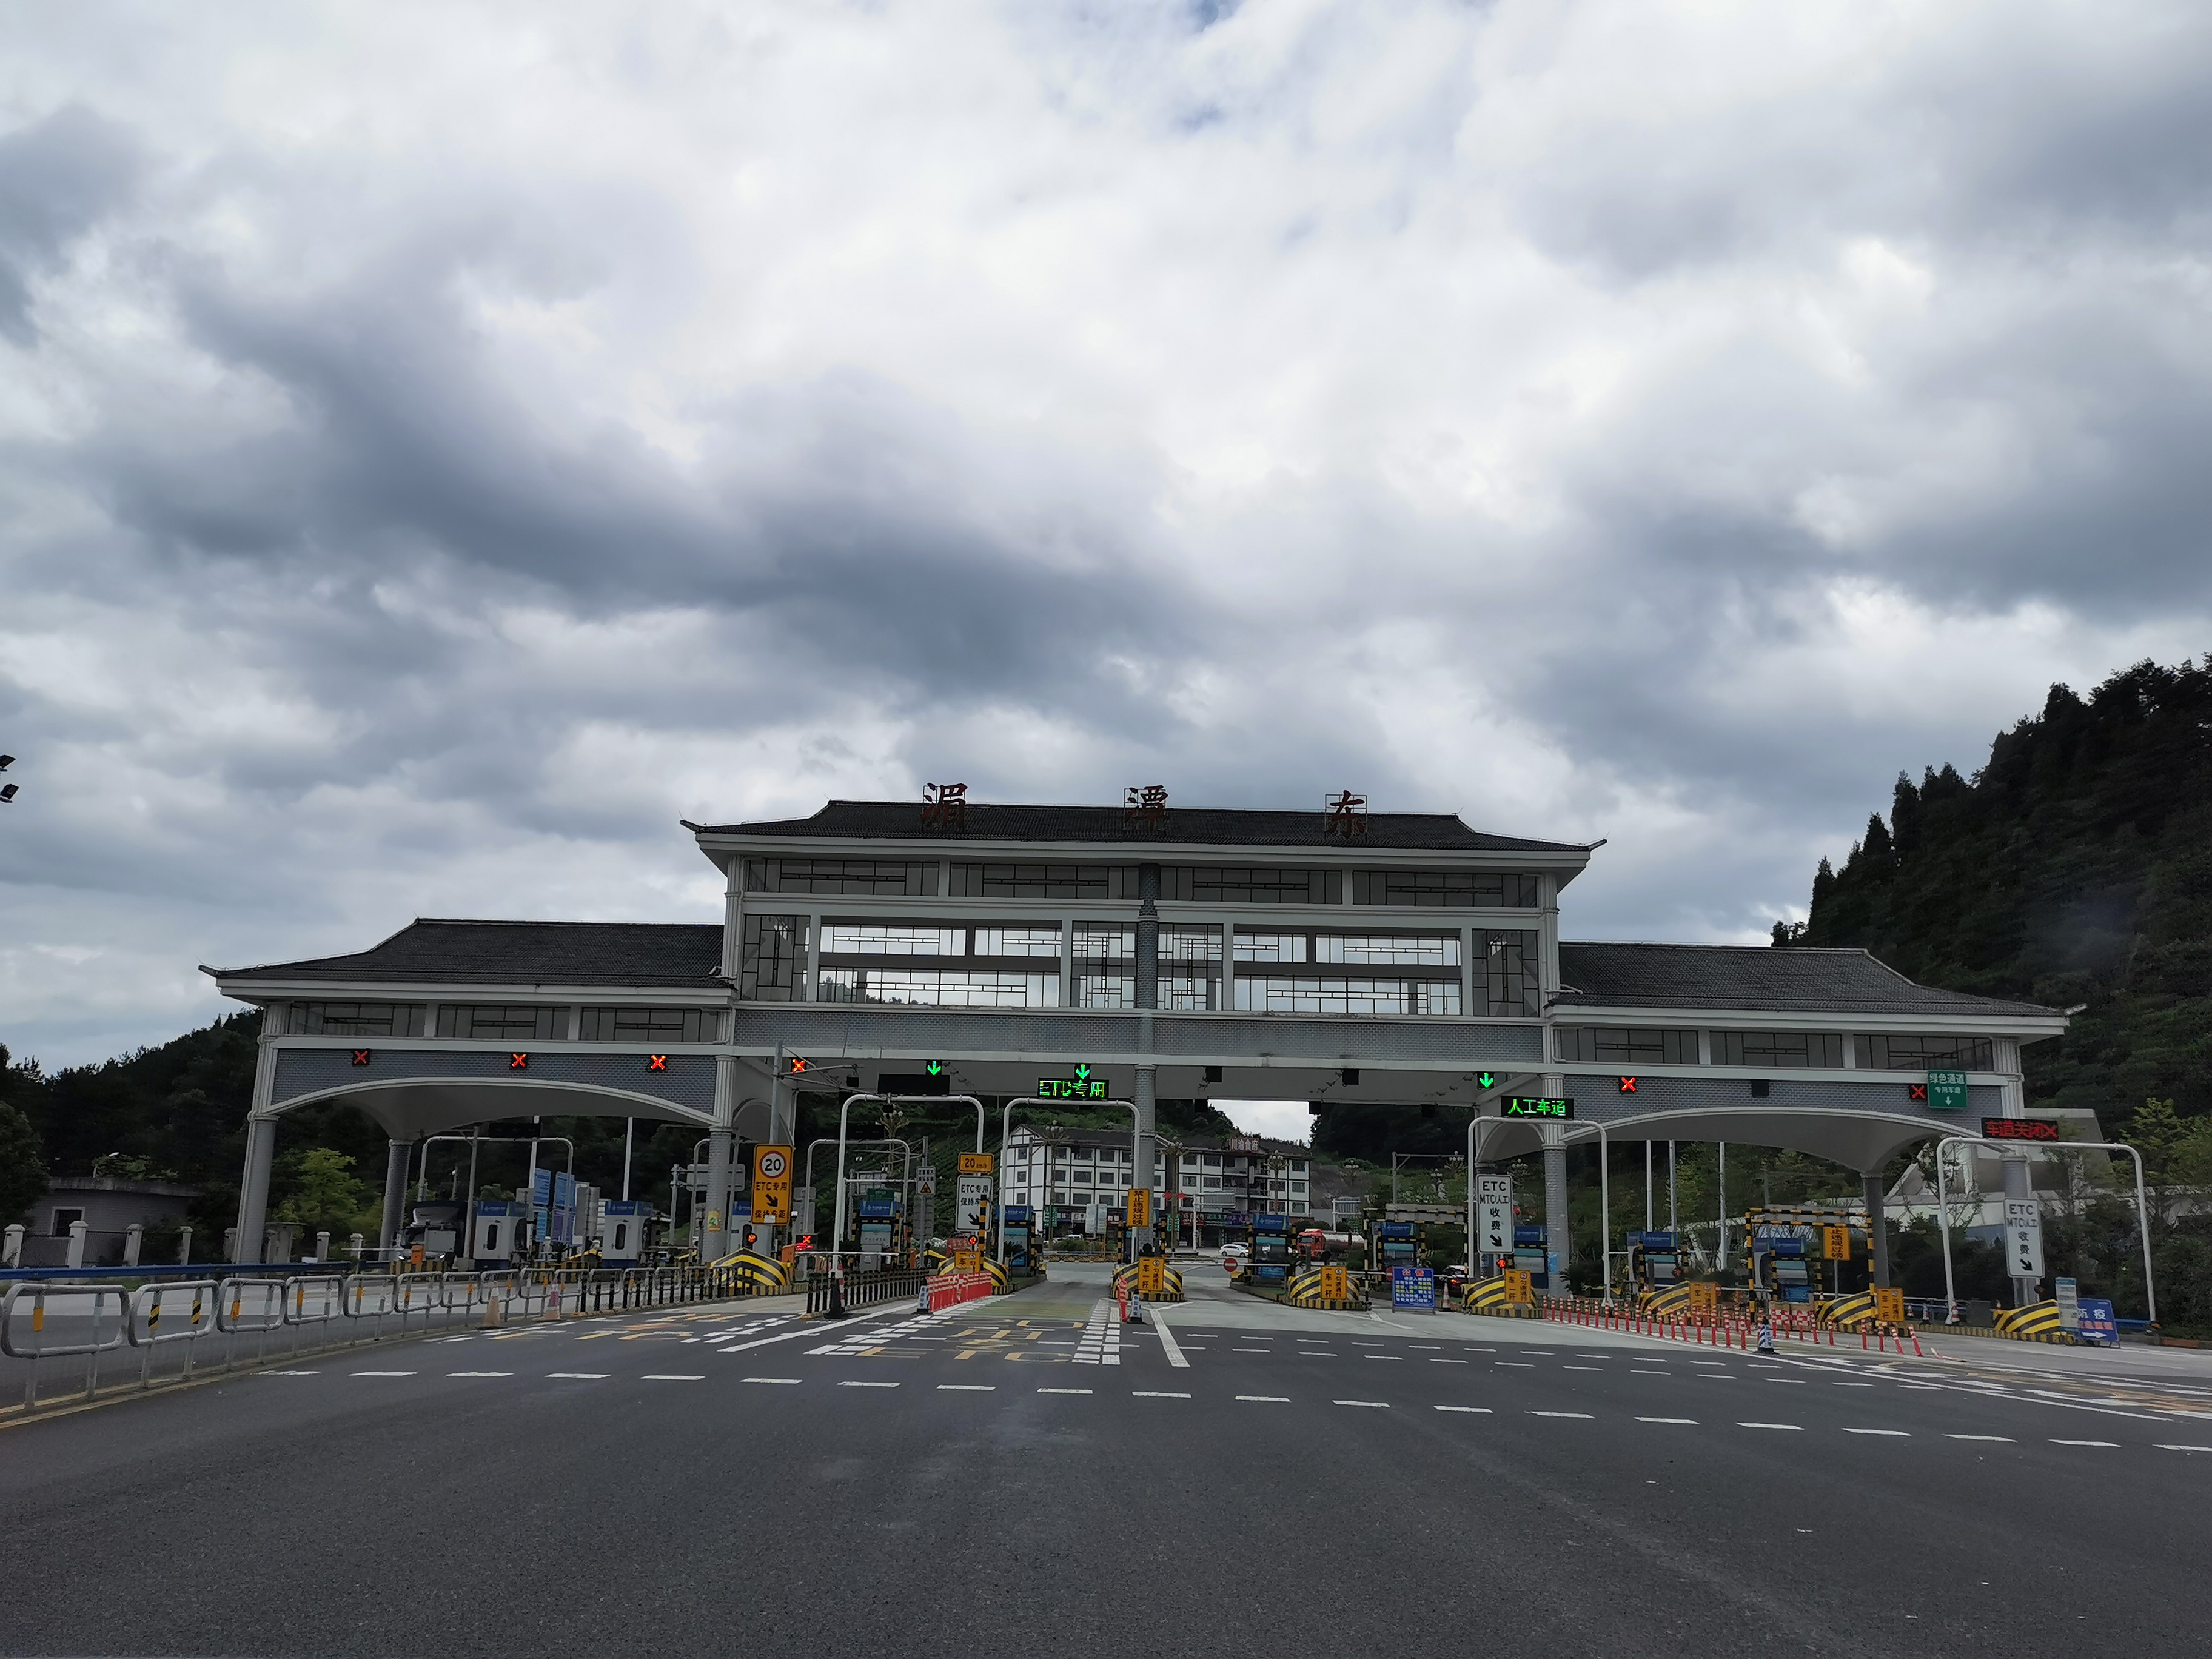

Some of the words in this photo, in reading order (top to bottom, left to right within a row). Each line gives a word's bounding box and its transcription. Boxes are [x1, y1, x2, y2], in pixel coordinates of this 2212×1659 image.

[922, 783, 1365, 839] 湄潭东
[1929, 1073, 1965, 1084] 绿色通道
[1039, 1080, 1105, 1097] ETC专用
[1507, 1098, 1566, 1116] 人工车道
[765, 1158, 781, 1171] 20
[964, 1158, 975, 1168] 20
[756, 1181, 787, 1191] ETC专用
[961, 1184, 988, 1193] ETC专用
[1483, 1181, 1506, 1191] ETC
[960, 1197, 981, 1206] 保持车
[2009, 1204, 2034, 1215] ETC
[1490, 1207, 1501, 1231] 收费
[1831, 1228, 1843, 1259] 止违规过磅
[2017, 1231, 2029, 1255] 收费
[855, 1347, 1073, 1362] ETC
